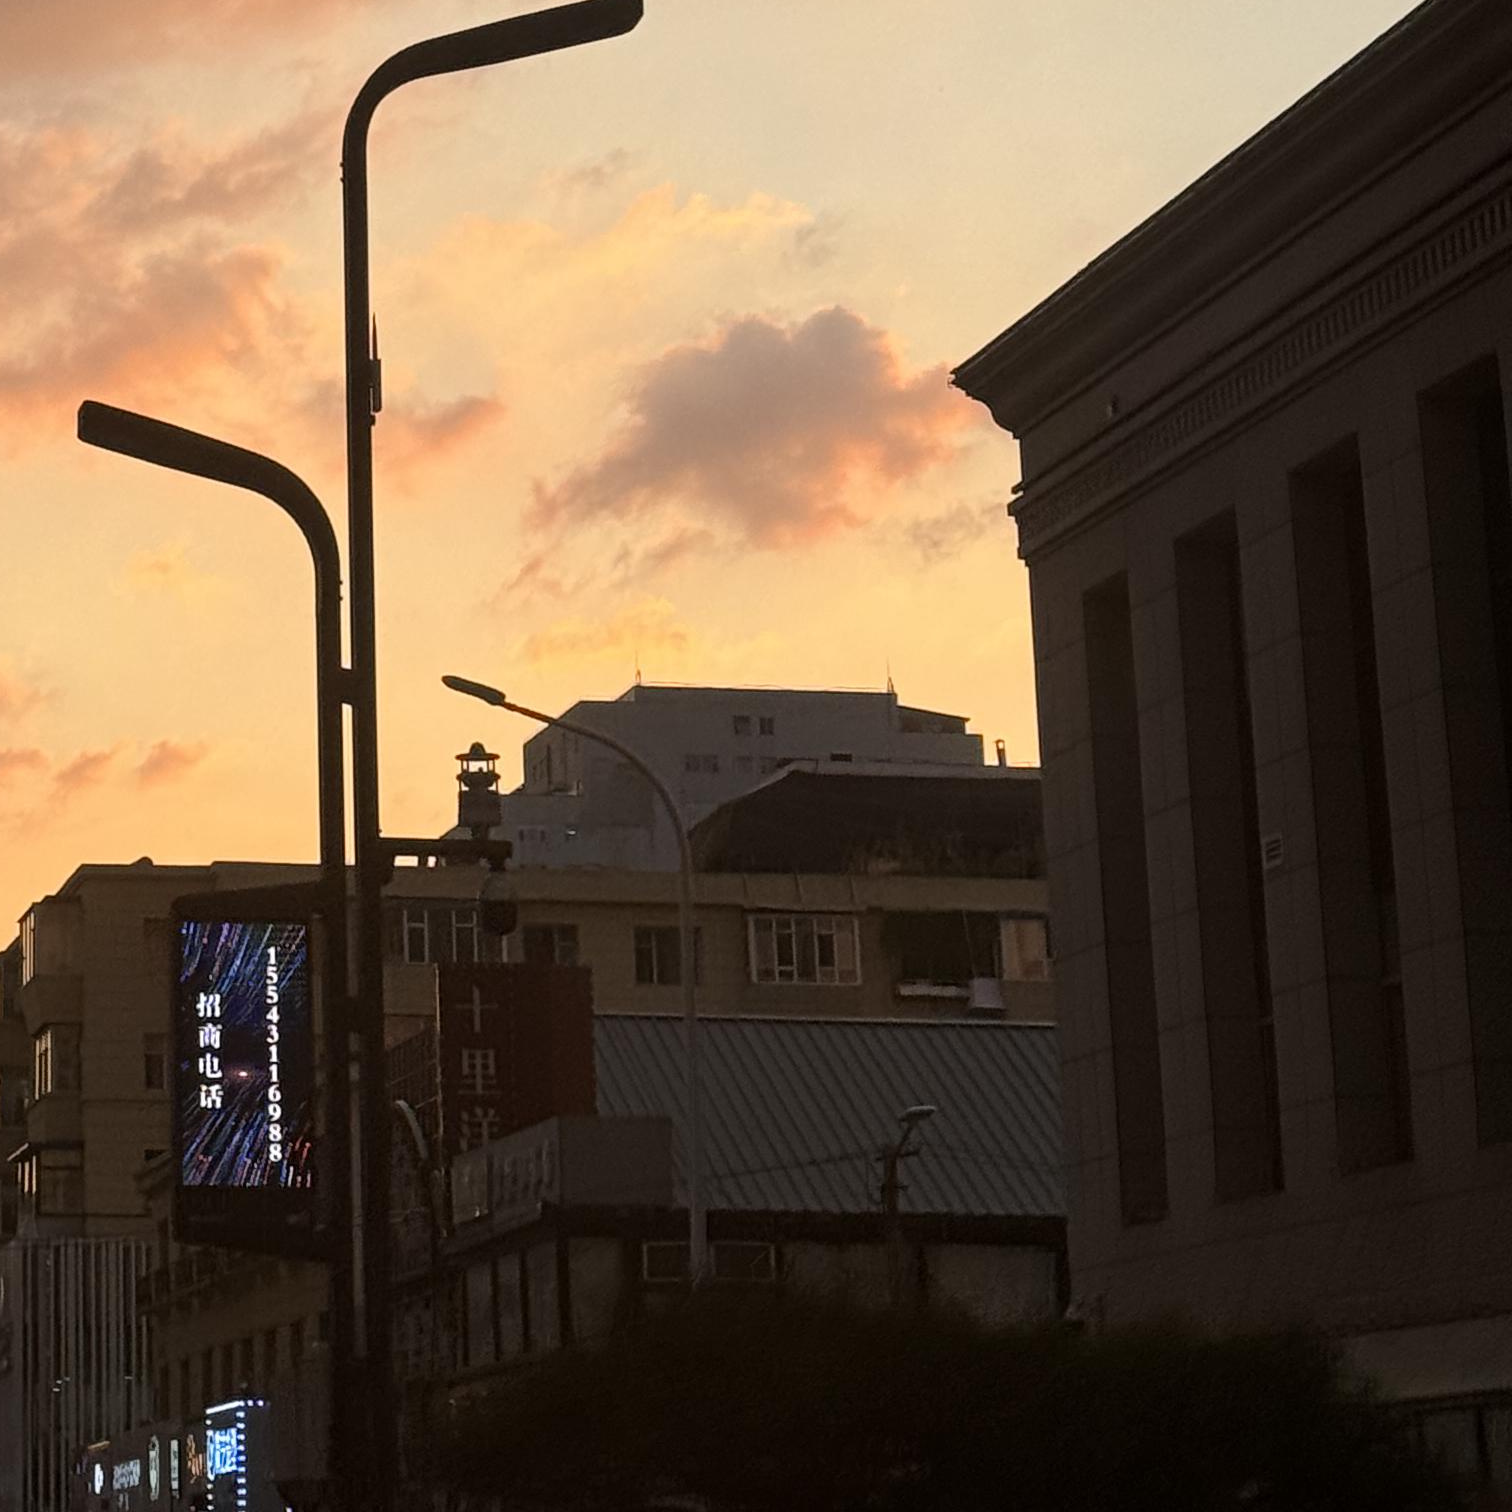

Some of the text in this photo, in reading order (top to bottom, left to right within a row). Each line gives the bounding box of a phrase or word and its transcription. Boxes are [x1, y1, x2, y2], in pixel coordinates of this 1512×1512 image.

[196, 992, 223, 1109] 招商电话
[265, 946, 283, 1163] 15543116988
